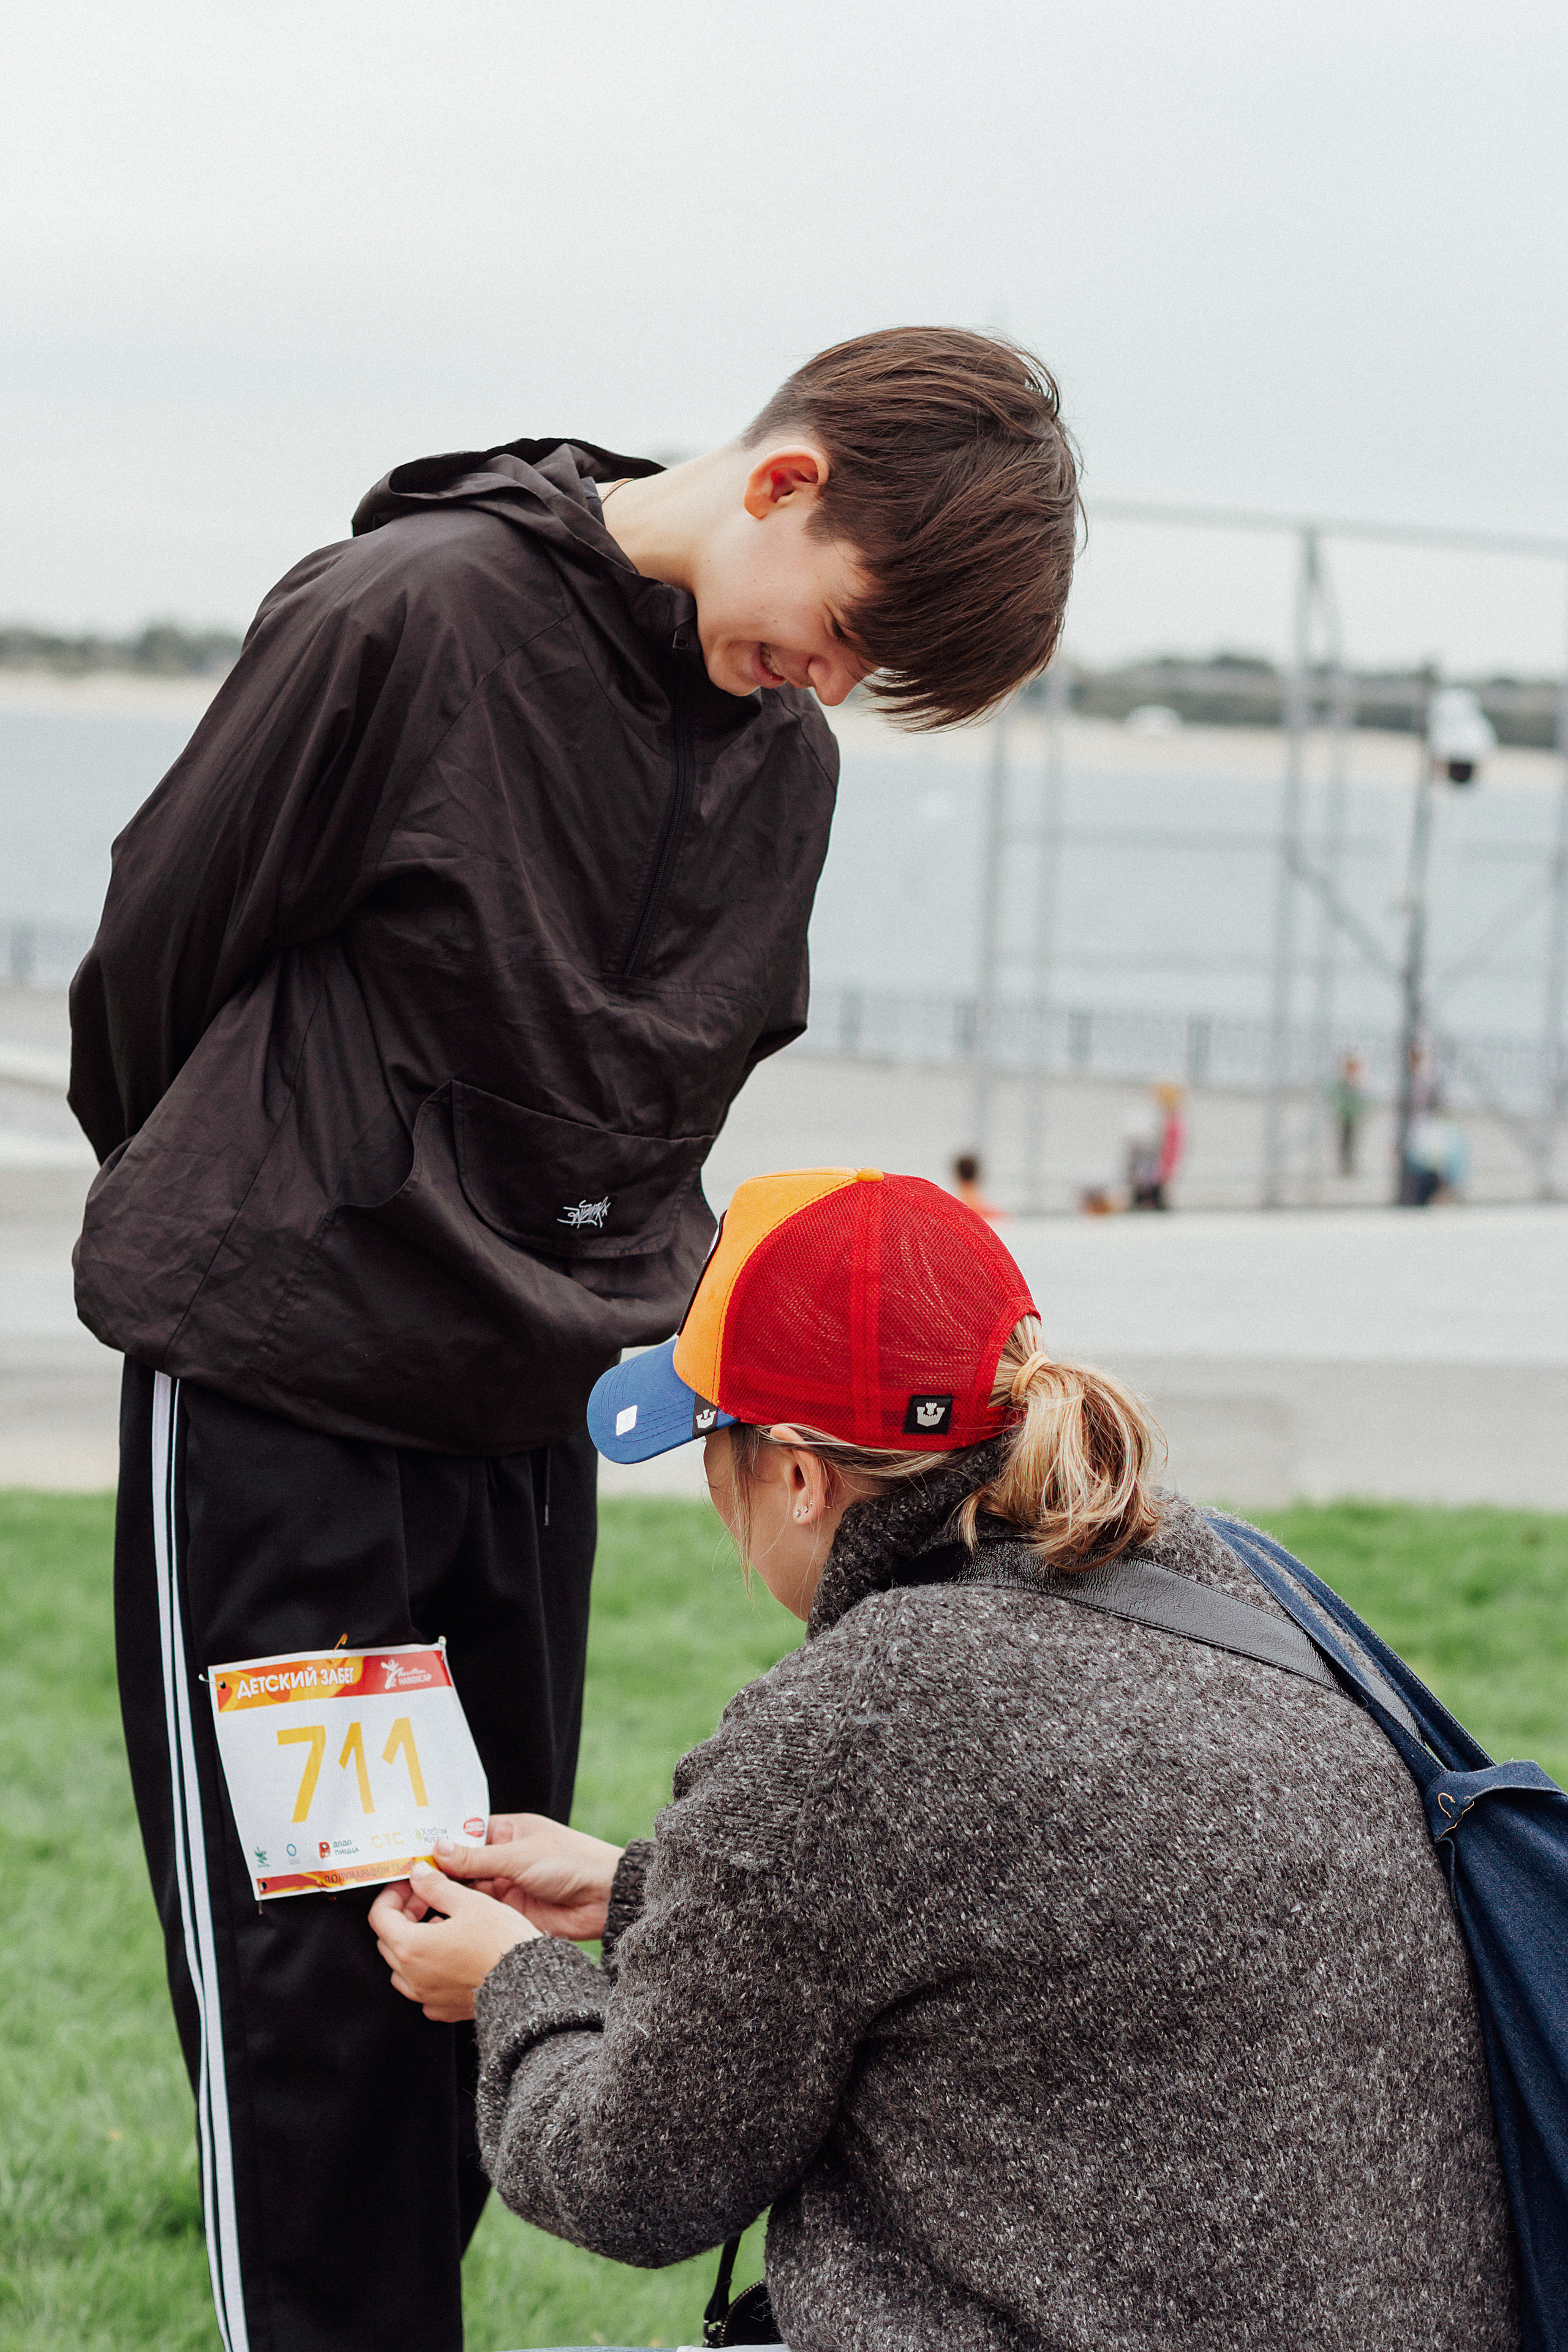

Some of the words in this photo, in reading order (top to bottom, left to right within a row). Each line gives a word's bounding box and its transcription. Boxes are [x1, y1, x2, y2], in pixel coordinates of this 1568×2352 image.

[237, 1667, 318, 1700] ДЕТСКИЙ
[320, 1667, 355, 1686] ЗАБЕГ
[276, 1717, 429, 1823] 711
[333, 1839, 353, 1849] ДОДО
[371, 1831, 404, 1849] СТС
[334, 1847, 360, 1856] ПИЦЦА
[324, 1864, 390, 1884] ПОЛУМАРАФОН
